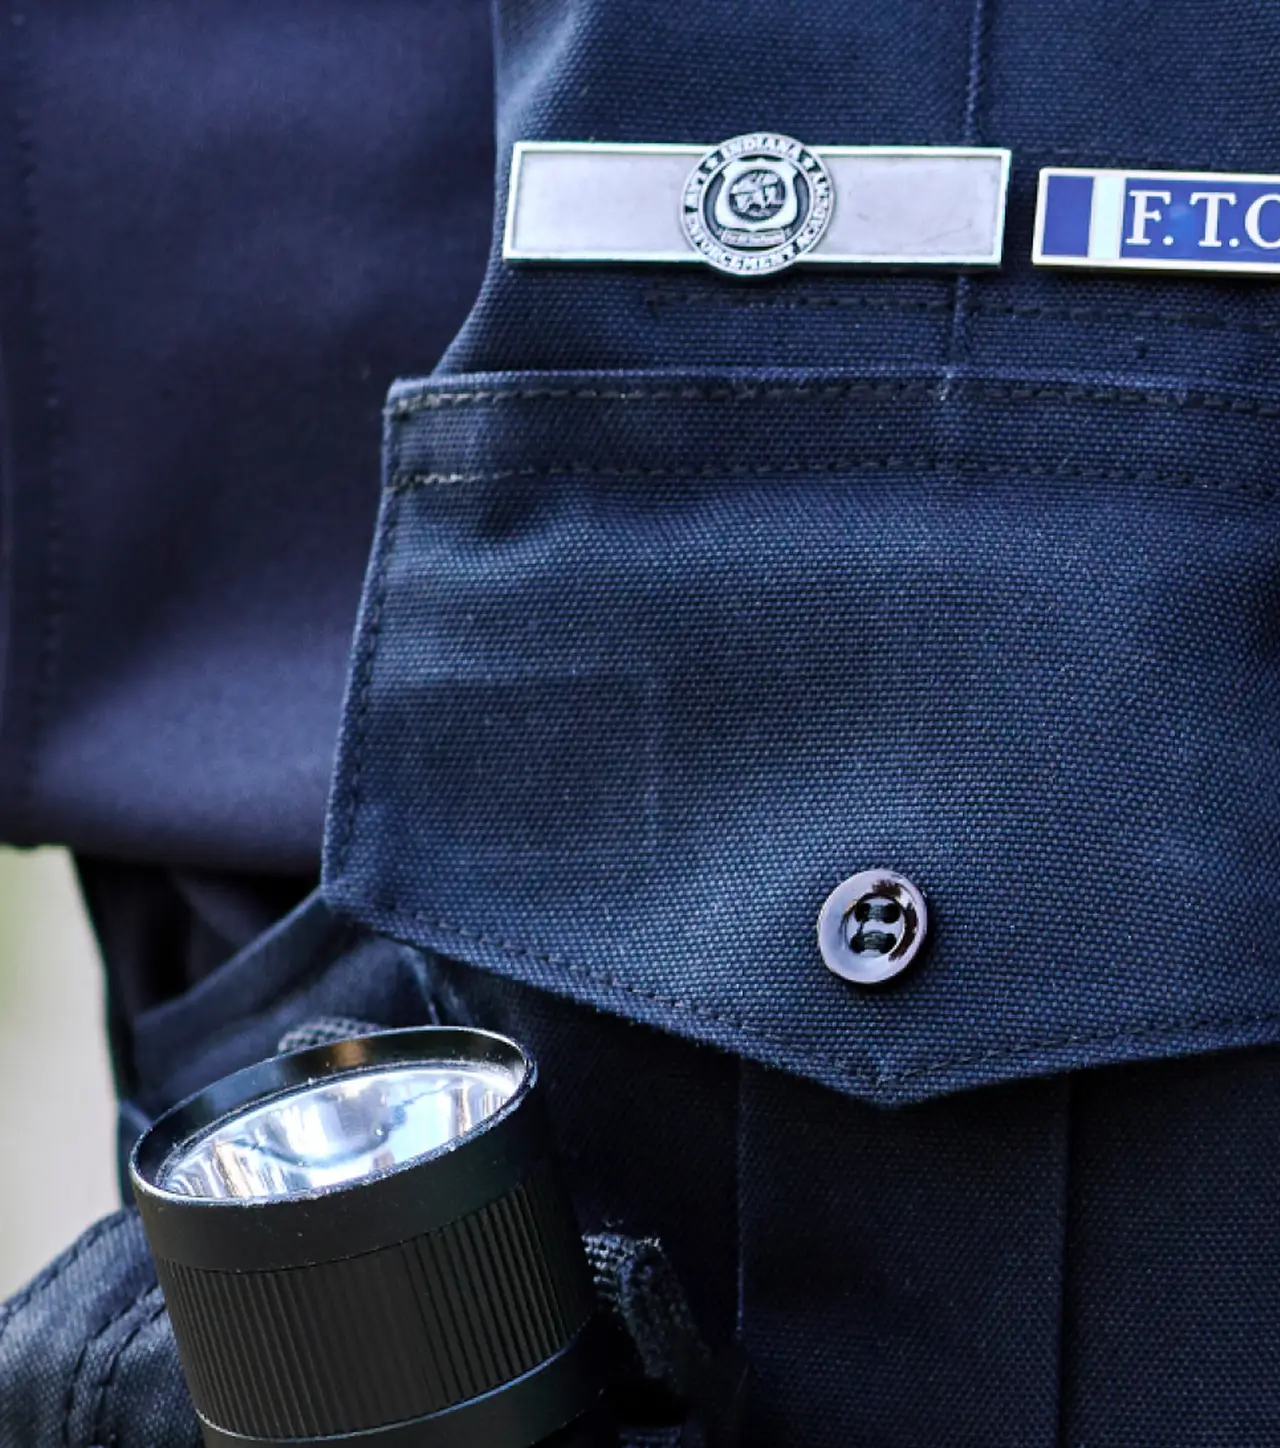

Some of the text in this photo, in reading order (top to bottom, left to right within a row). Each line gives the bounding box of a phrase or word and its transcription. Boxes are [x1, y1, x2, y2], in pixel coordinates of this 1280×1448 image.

[721, 136, 802, 162] INDIANA
[684, 212, 796, 271] ENFORCEMENT
[796, 170, 830, 250] ACADEMY
